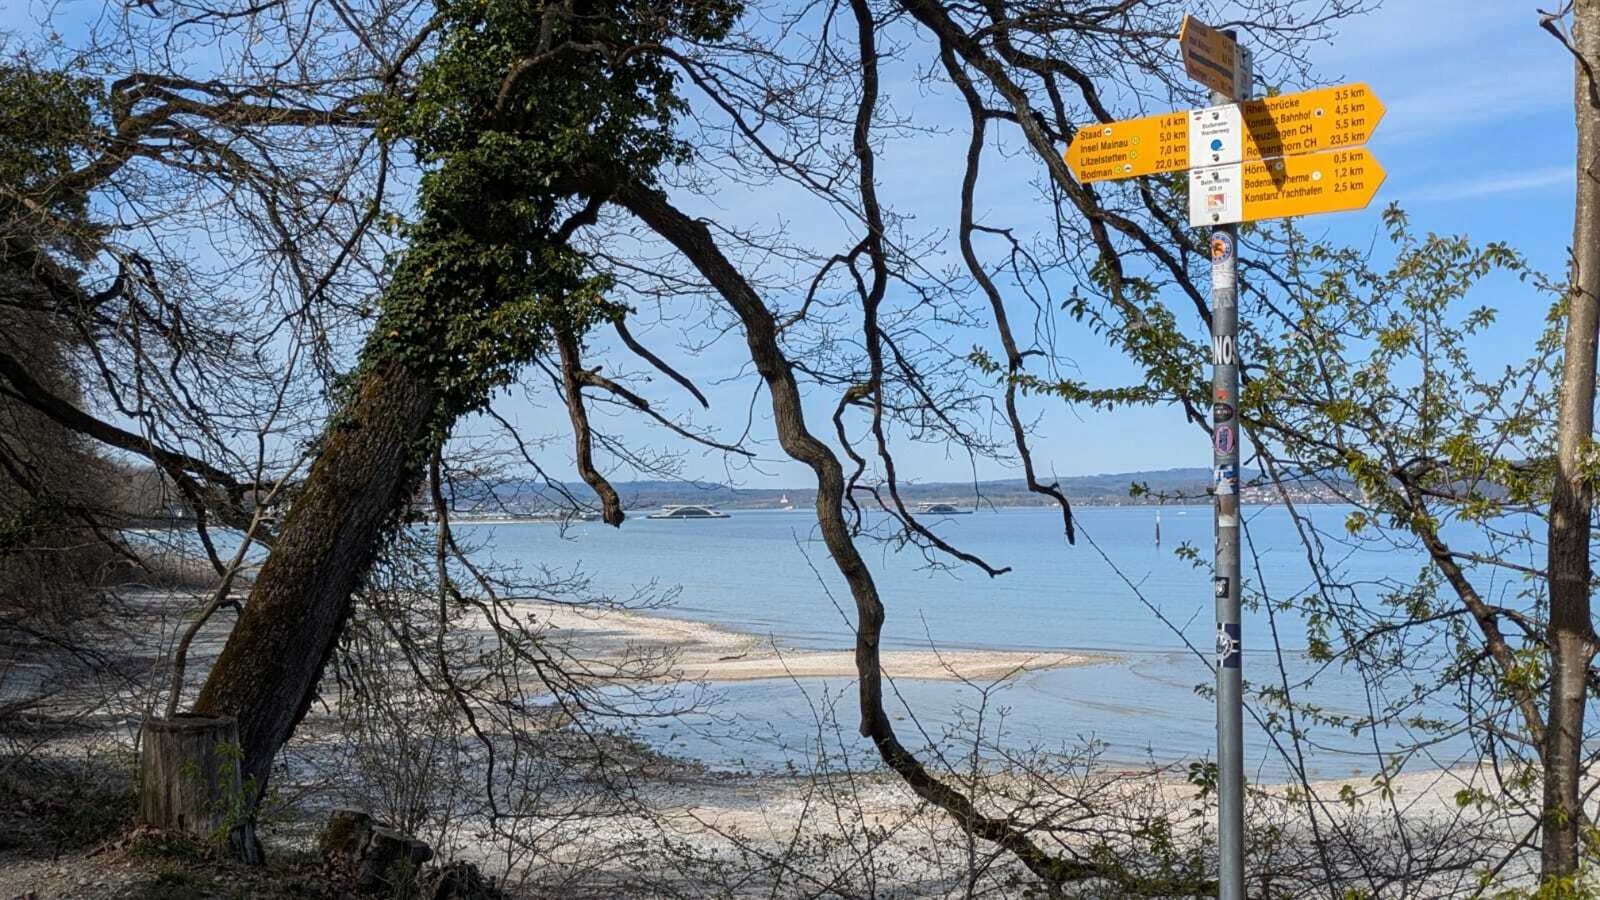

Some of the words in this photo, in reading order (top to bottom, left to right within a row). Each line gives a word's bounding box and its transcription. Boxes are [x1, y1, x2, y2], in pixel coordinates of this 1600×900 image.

[1246, 99, 1300, 113] Rheinbrücke
[1335, 91, 1348, 102] 3,5
[1350, 89, 1364, 98] km
[1280, 110, 1311, 123] Bahnhof
[1335, 105, 1348, 115] 4,5
[1351, 103, 1365, 112] km
[1080, 130, 1102, 140] Staad
[1160, 118, 1171, 129] 1,4
[1174, 117, 1186, 126] km
[1246, 128, 1296, 142] Kreuzlingen
[1300, 124, 1312, 134] CH
[1336, 119, 1348, 130] 5,5
[1351, 118, 1365, 126] km
[1080, 144, 1098, 153] Insel
[1100, 140, 1128, 150] Mainau
[1160, 132, 1172, 142] 5,0
[1174, 130, 1186, 140] km
[1160, 146, 1172, 156] 7,0
[1174, 144, 1186, 153] km
[1304, 138, 1317, 148] CH
[1330, 134, 1349, 145] 23,5
[1351, 132, 1365, 141] km
[1334, 154, 1347, 164] 0,5
[1350, 152, 1364, 161] km
[1080, 168, 1112, 180] Bodman
[1155, 159, 1172, 170] 22,0
[1174, 158, 1186, 166] km
[1334, 168, 1347, 178] 1,2
[1350, 167, 1364, 176] km
[1245, 192, 1278, 203] Konstanz
[1281, 186, 1322, 198] Yachthafen
[1334, 183, 1348, 193] 2,5
[1350, 182, 1364, 190] km
